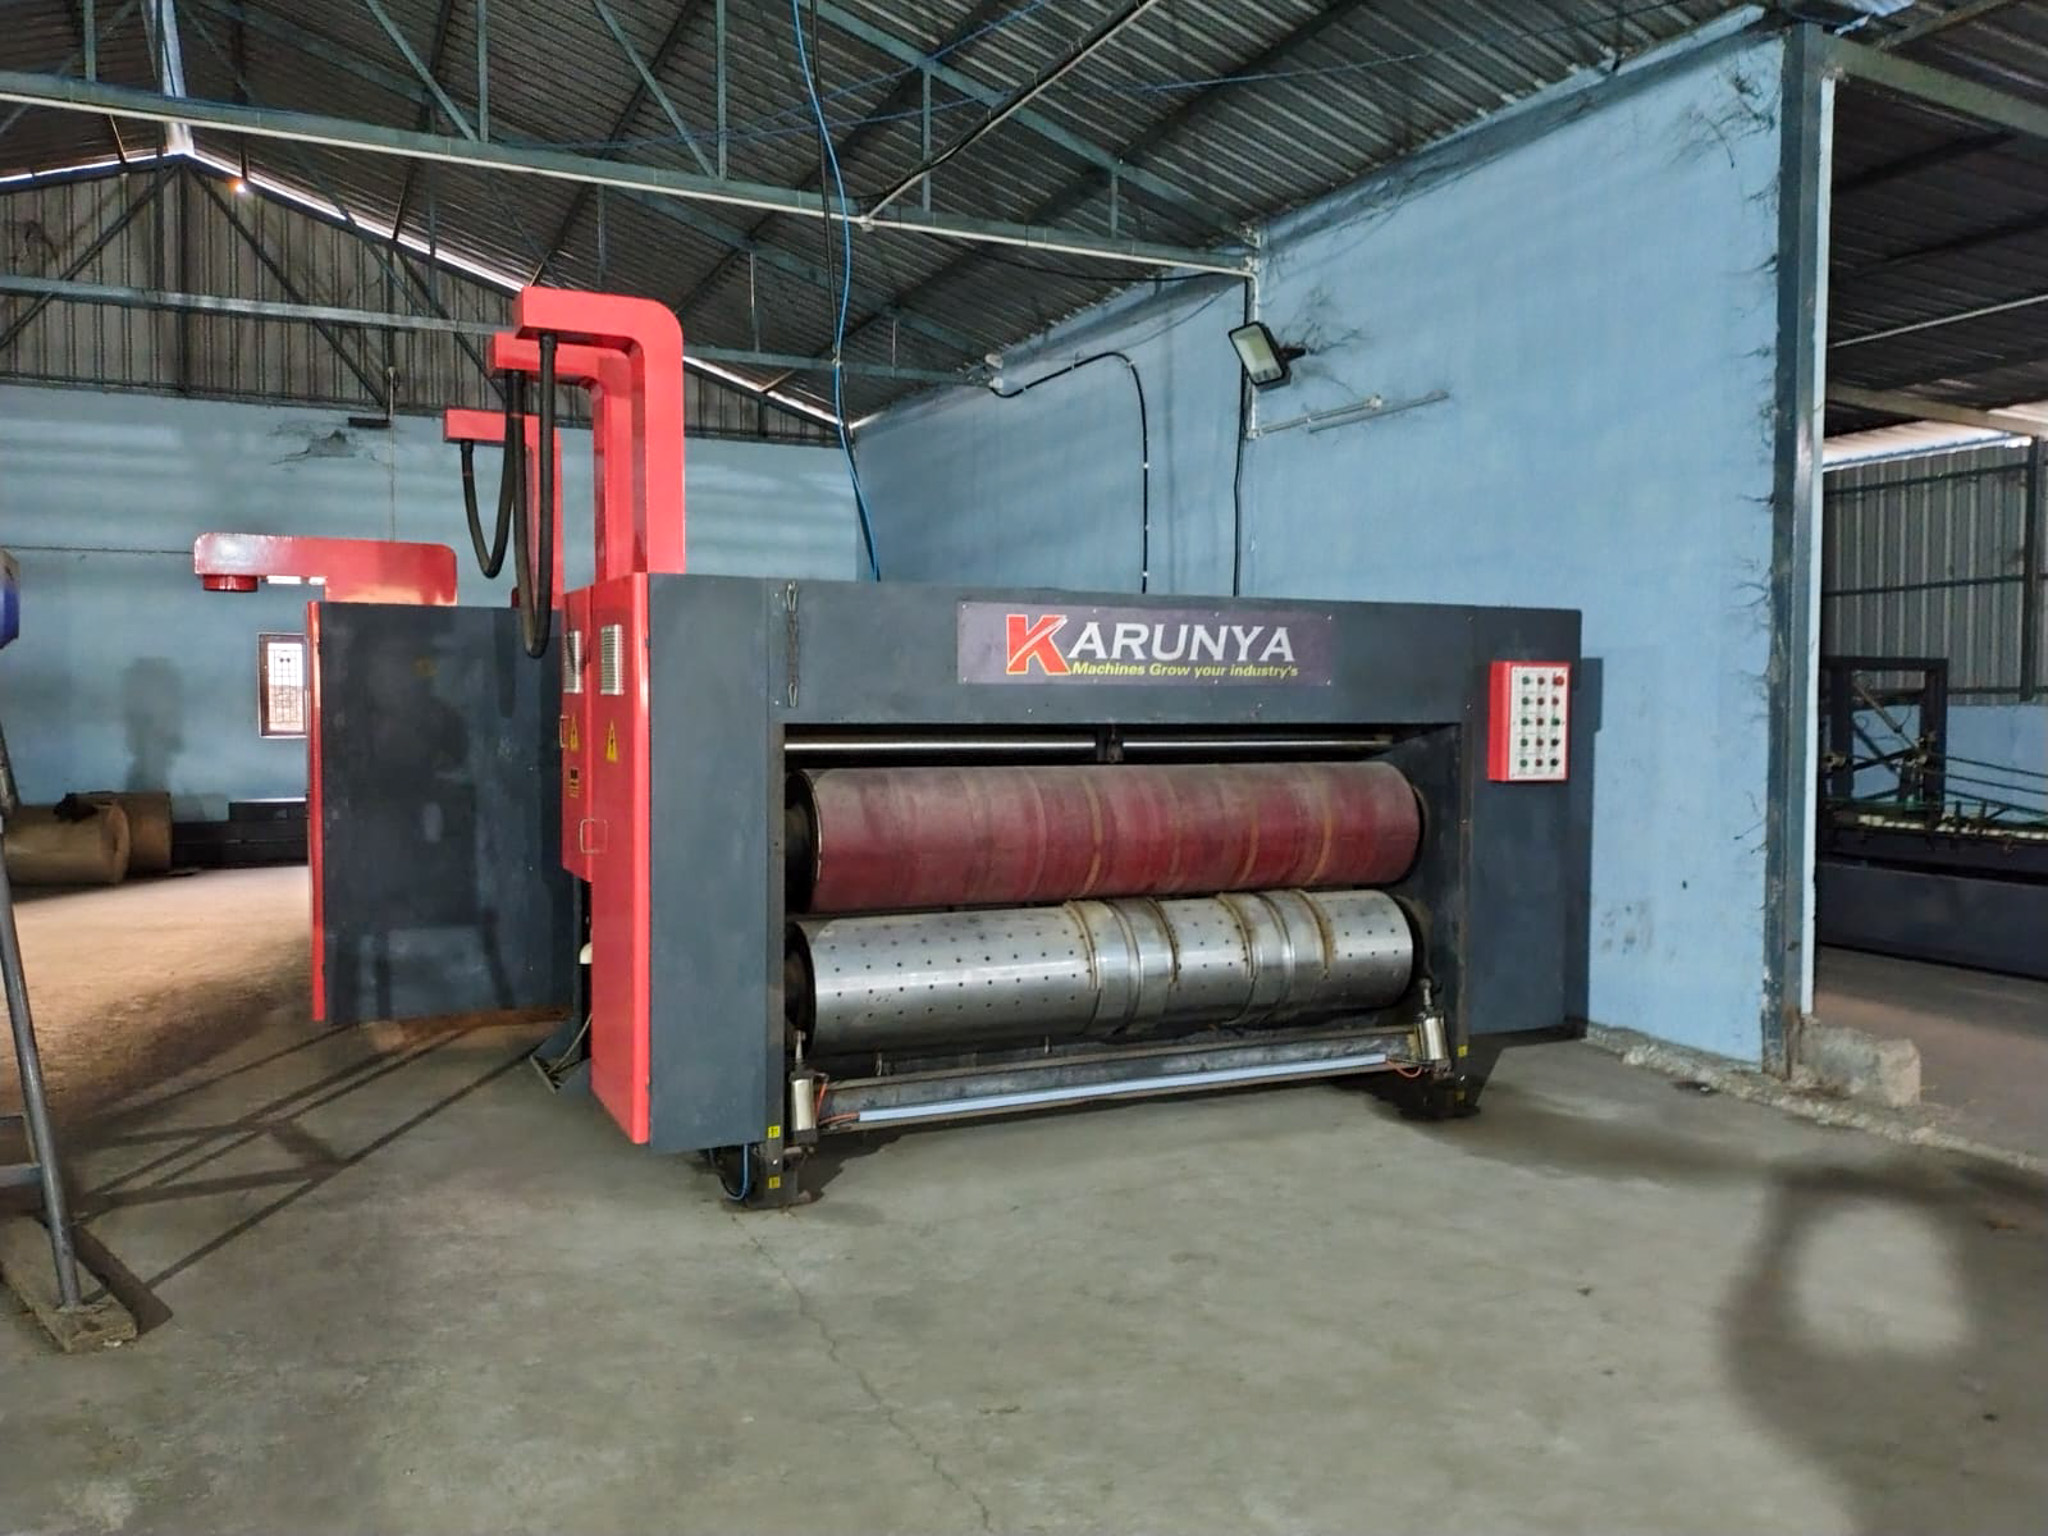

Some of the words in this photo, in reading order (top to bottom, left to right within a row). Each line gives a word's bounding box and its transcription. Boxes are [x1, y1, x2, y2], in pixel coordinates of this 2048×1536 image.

[1006, 614, 1295, 676] KARUNYA
[1072, 662, 1145, 675] Machines
[1150, 663, 1190, 676] Grow
[1194, 666, 1226, 678] your
[1230, 664, 1298, 679] industry's
